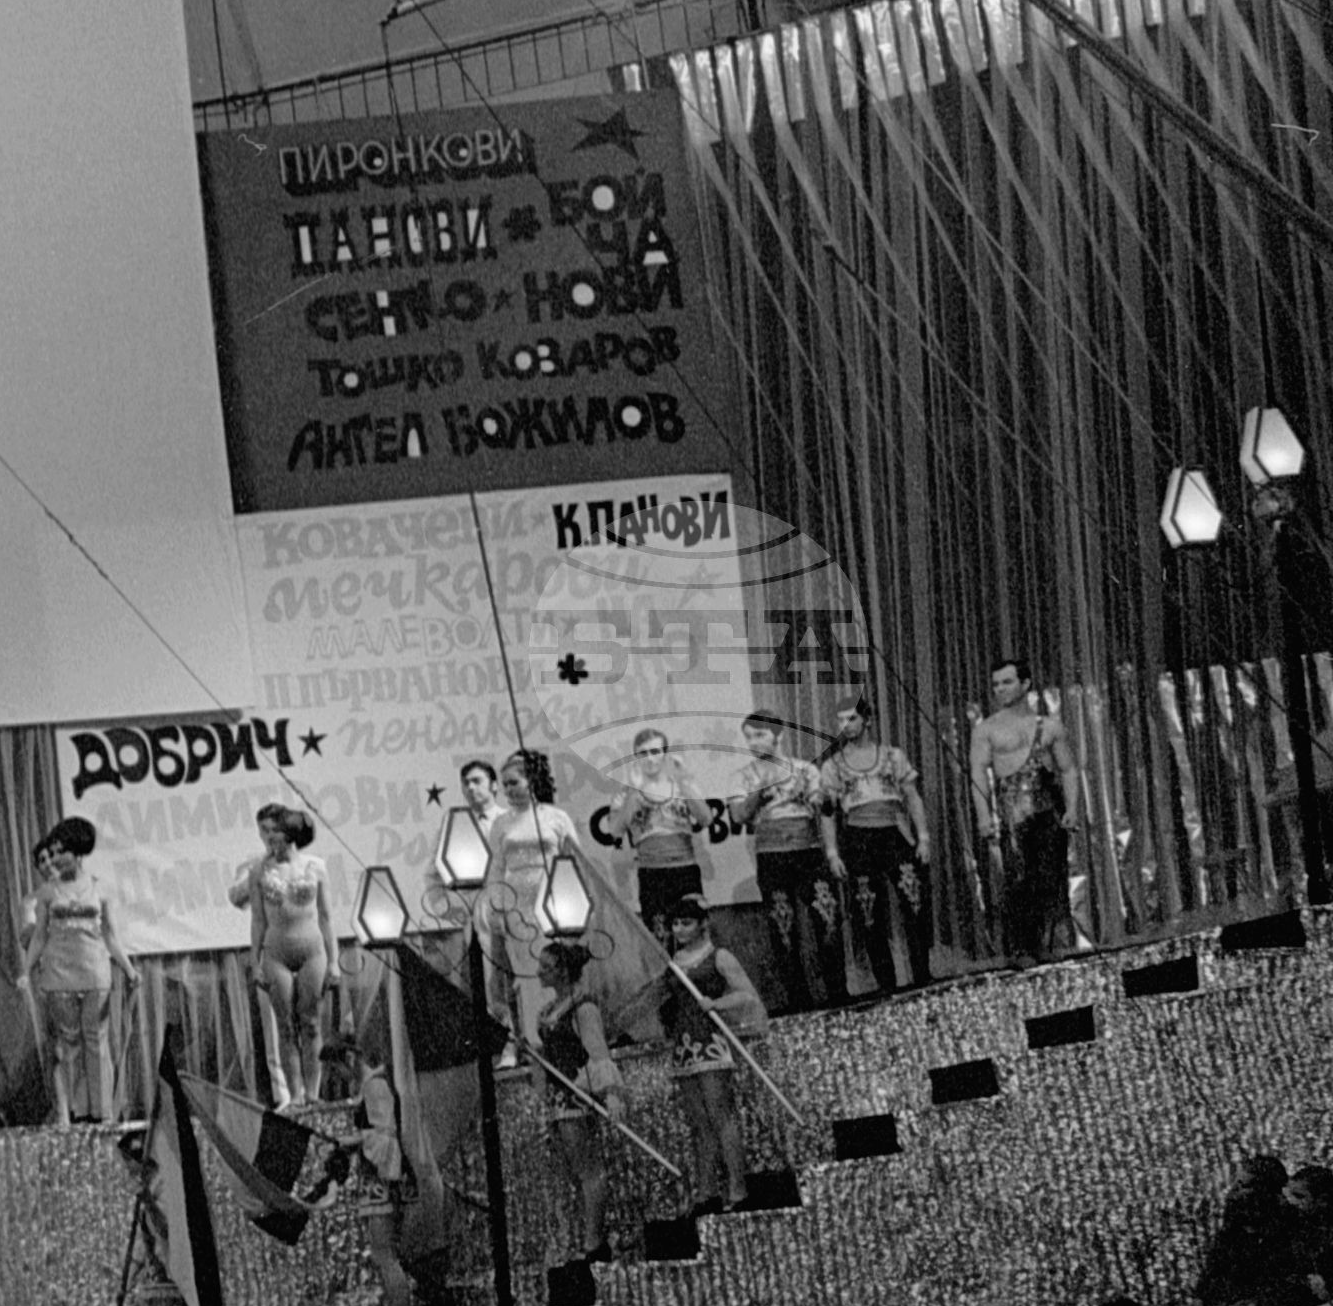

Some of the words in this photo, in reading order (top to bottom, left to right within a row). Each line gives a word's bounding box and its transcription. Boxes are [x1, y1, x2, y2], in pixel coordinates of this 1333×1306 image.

[277, 127, 533, 193] ПИРОНКОВИ
[287, 411, 429, 471] АНГЕЛ
[441, 391, 686, 457] БОЖИЛОВ
[71, 715, 298, 801] ДОБРИЧ
